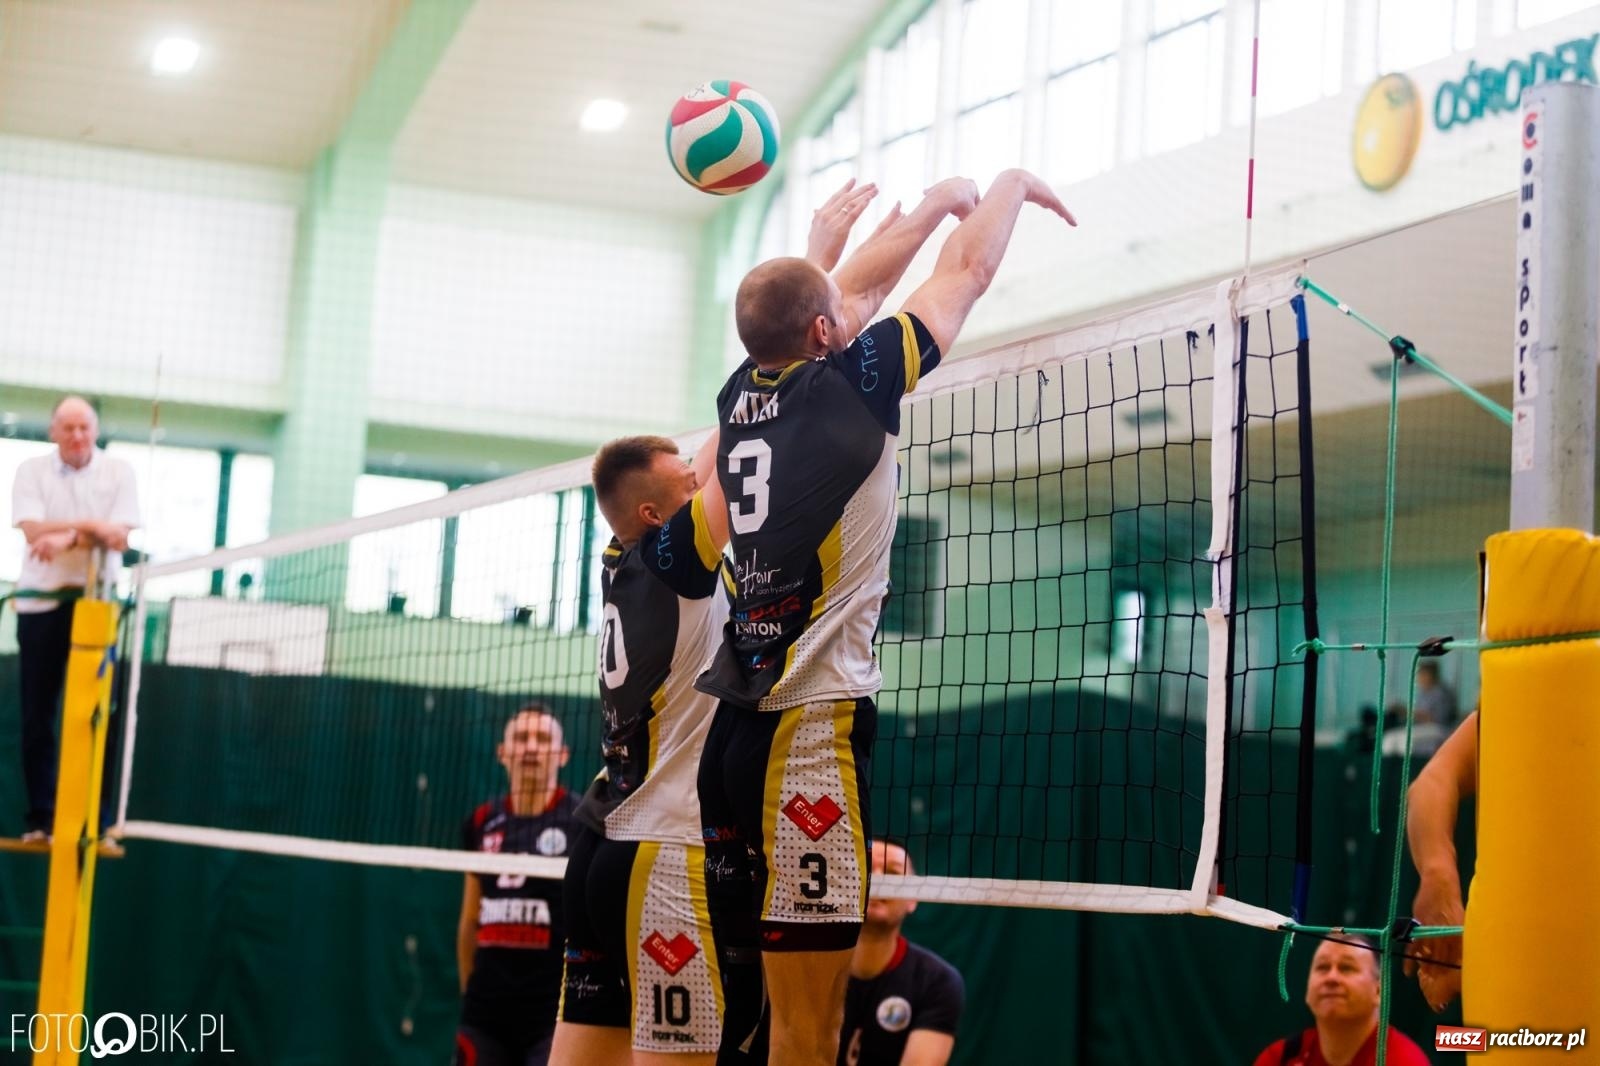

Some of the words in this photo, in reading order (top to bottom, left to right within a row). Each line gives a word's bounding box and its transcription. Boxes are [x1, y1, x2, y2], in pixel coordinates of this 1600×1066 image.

[728, 438, 772, 535] 3
[793, 801, 824, 829] Enter
[800, 853, 827, 899] 3
[651, 937, 680, 964] Enter
[653, 984, 691, 1026] 10
